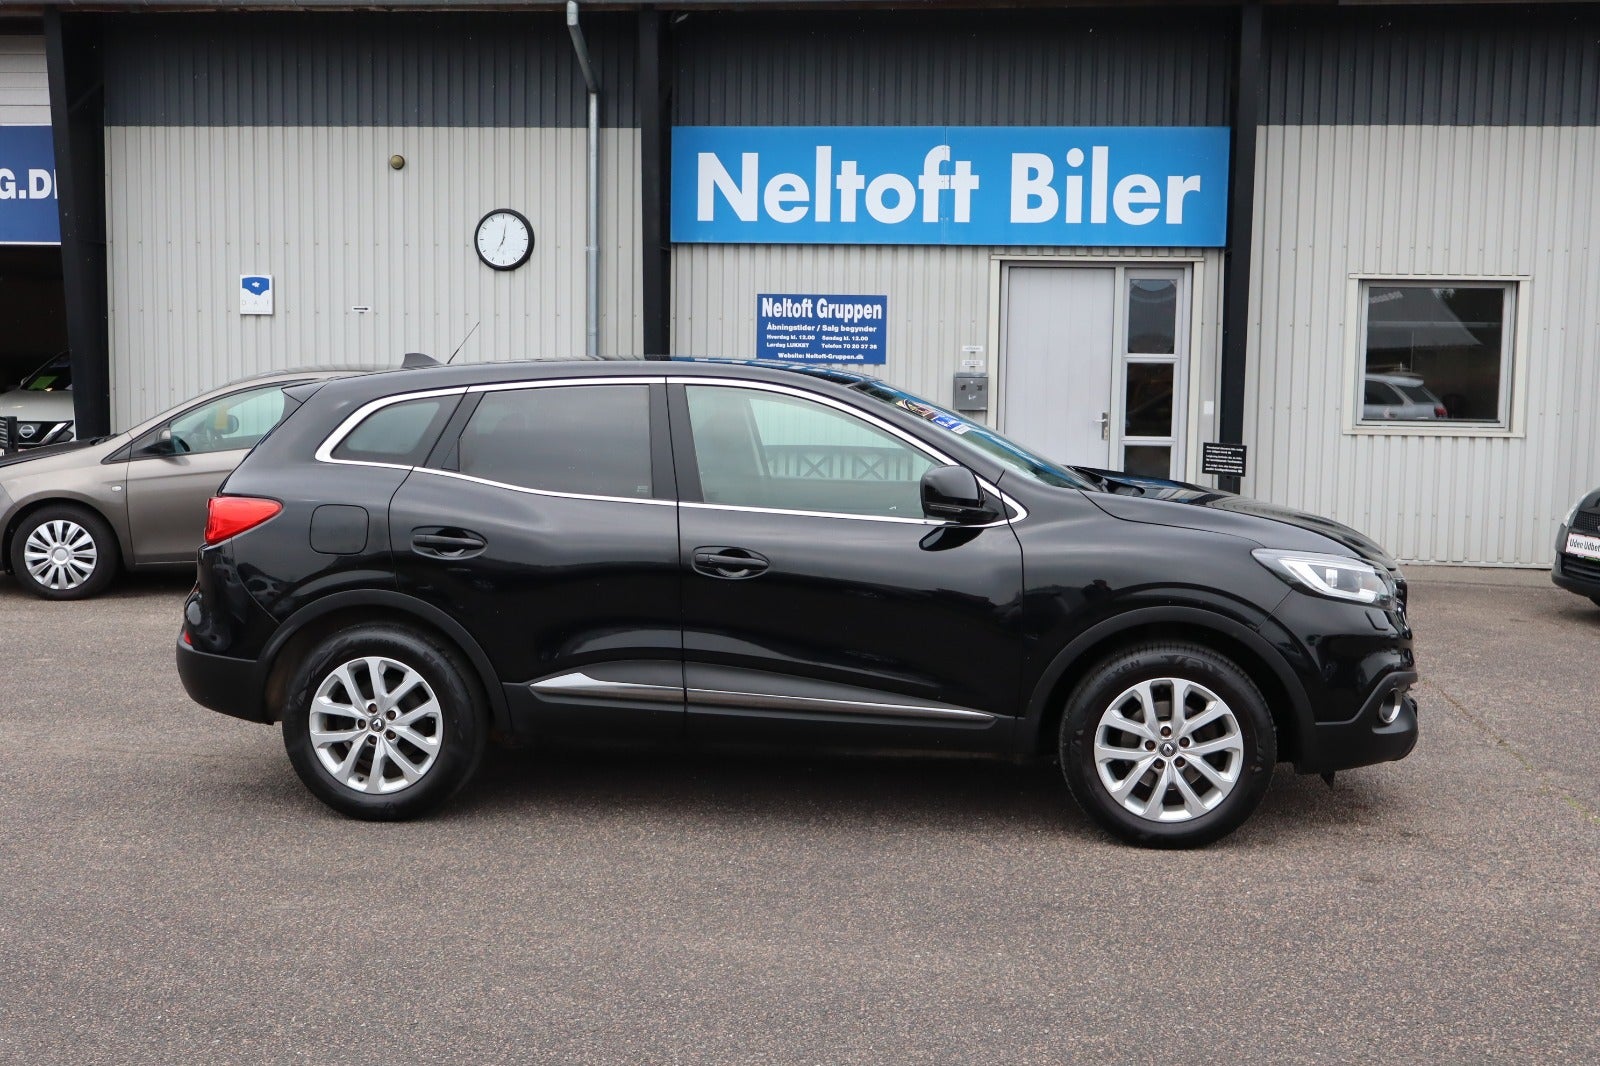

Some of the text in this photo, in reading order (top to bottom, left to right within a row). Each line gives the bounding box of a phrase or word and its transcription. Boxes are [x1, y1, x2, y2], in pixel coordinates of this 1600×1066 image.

[0, 168, 57, 199] G.D
[697, 145, 1200, 225] Neltoft Biler
[762, 298, 882, 323] Neltoft Gruppen
[766, 322, 815, 331] Åbningstider
[840, 325, 877, 333] begynder
